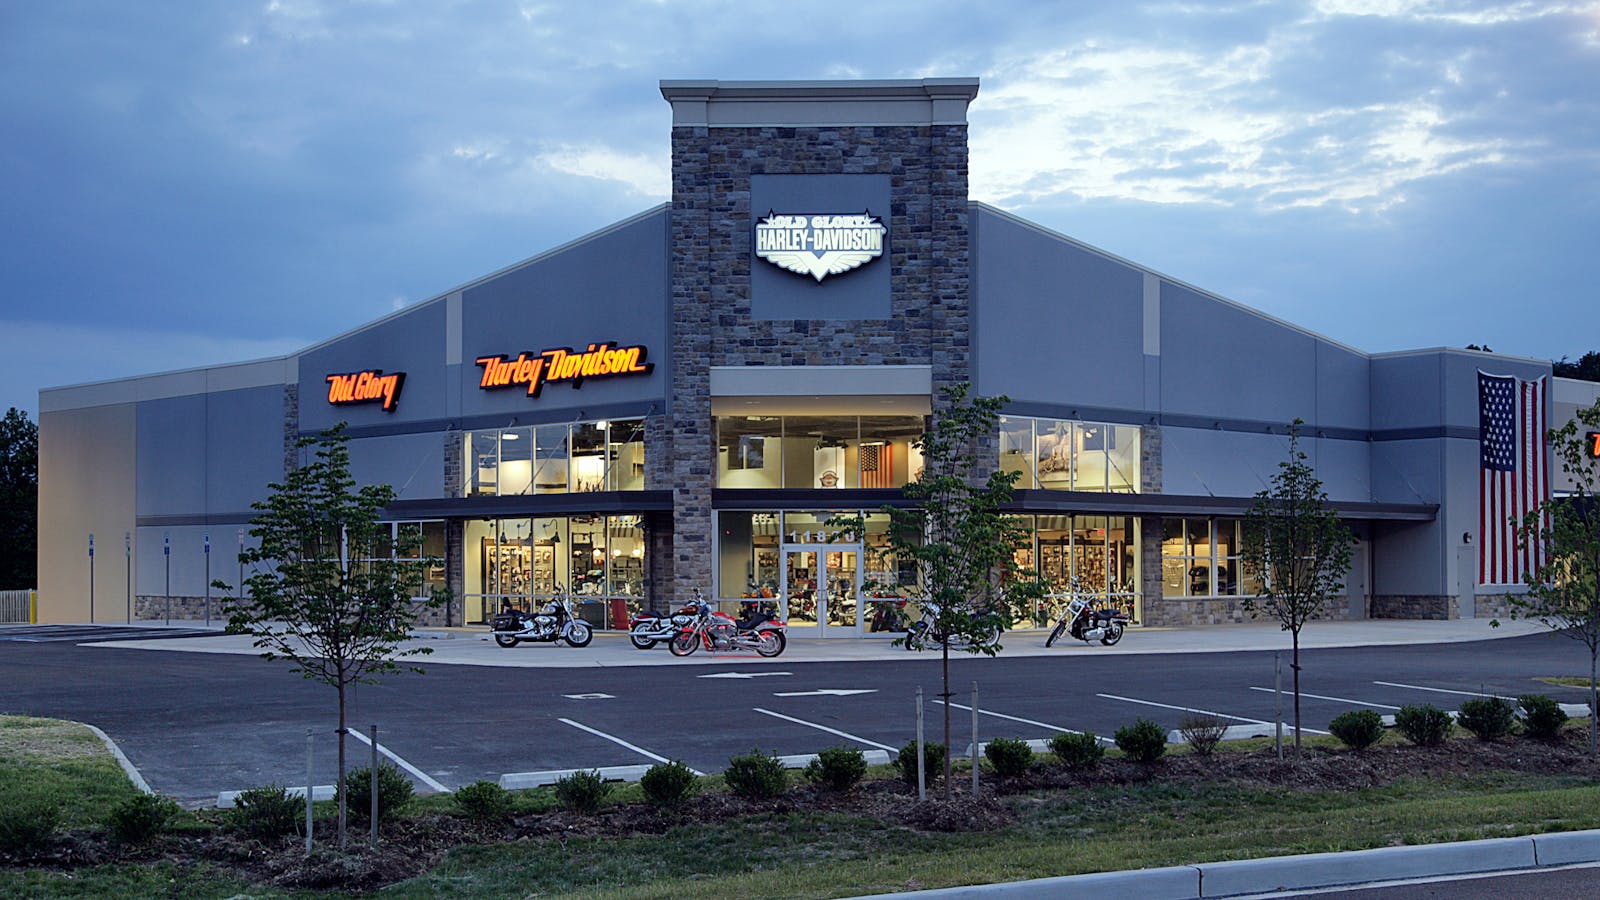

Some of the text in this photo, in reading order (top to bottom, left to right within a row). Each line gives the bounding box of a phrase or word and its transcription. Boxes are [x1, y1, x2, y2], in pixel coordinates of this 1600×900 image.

[774, 216, 807, 229] OLD
[758, 229, 881, 250] HARLEY-DAVIDSON
[476, 344, 647, 395] Harley-Davidson
[327, 372, 398, 409] Old Glory
